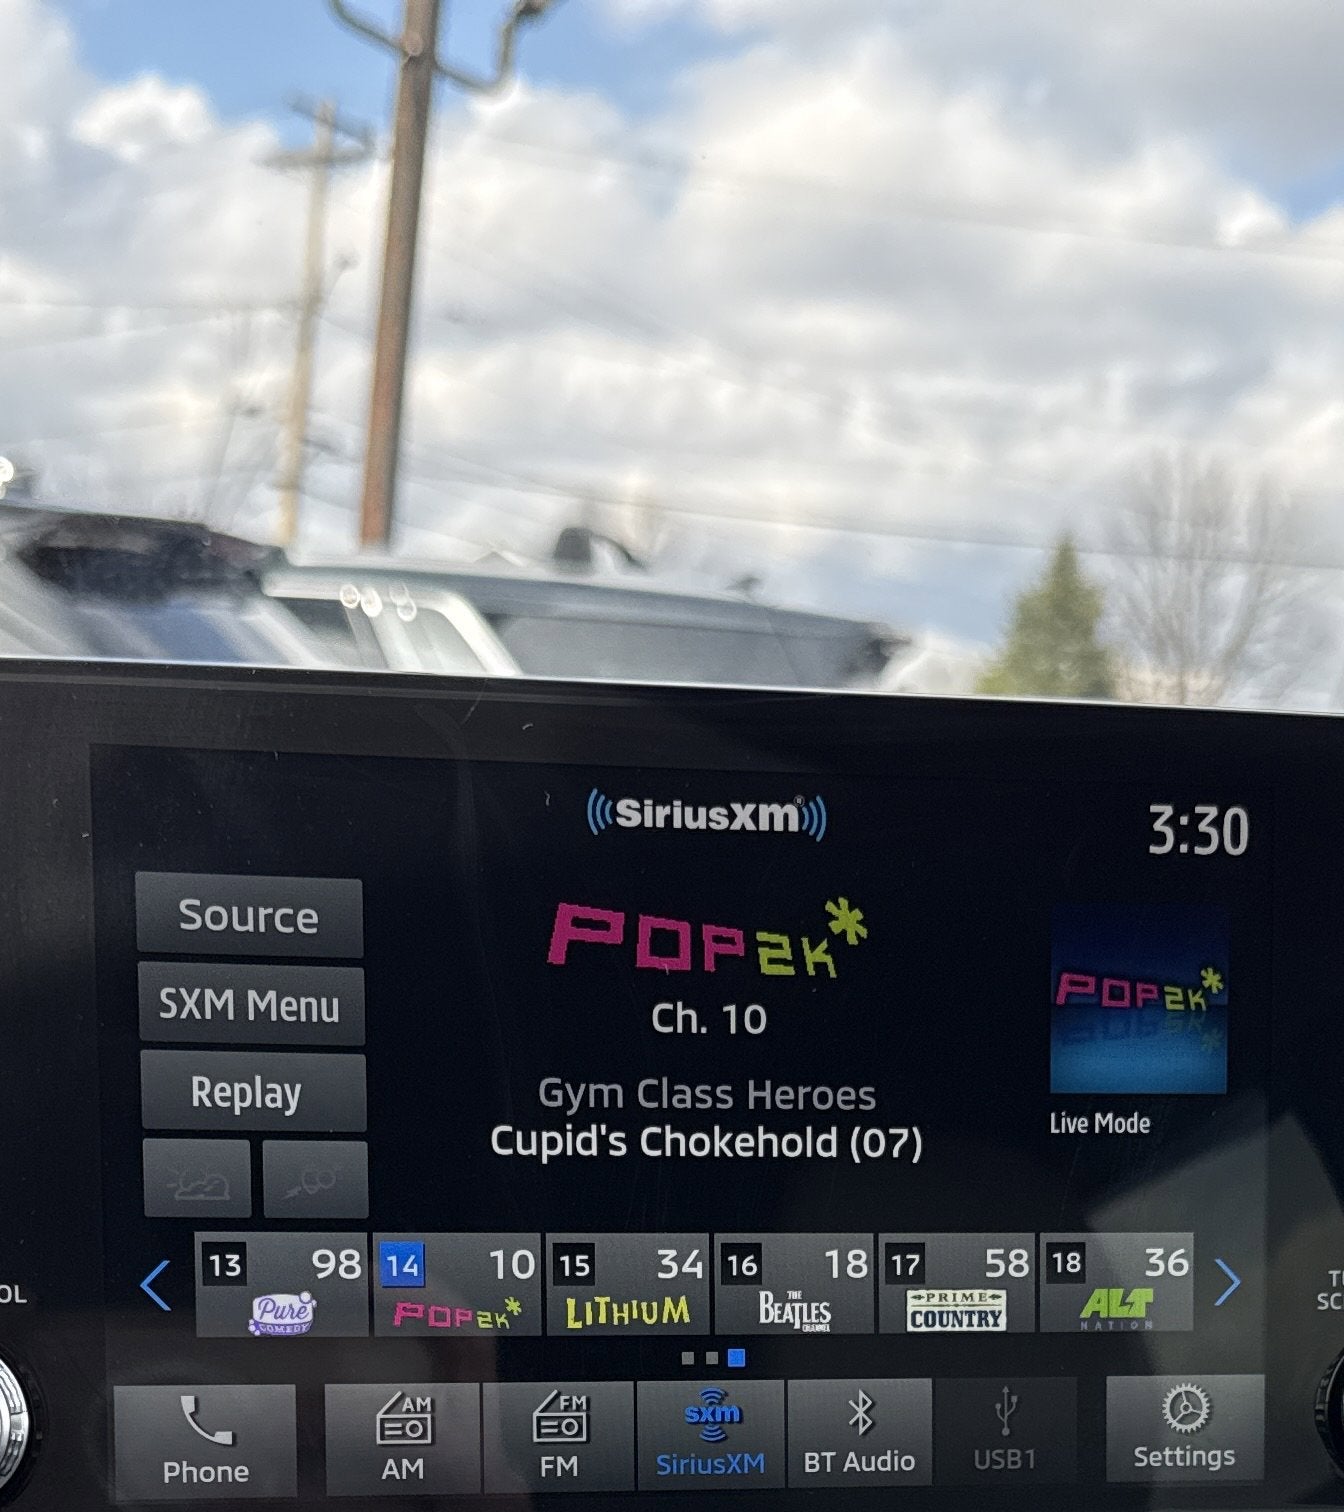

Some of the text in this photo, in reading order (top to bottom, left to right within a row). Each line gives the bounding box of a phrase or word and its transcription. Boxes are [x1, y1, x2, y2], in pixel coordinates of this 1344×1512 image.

[1149, 804, 1249, 855] 3:30
[178, 899, 319, 934] Source
[159, 986, 340, 1023] SXM Menu
[652, 1002, 767, 1034] Ch. 10
[191, 1076, 301, 1115] Replay
[539, 1077, 877, 1115] Gym Class Heroes
[1050, 1112, 1151, 1134] Live Mode
[491, 1124, 923, 1163] Cupid's Chokehold (07)
[209, 1254, 241, 1277] 13
[312, 1248, 362, 1280] 98
[387, 1256, 419, 1277] 14
[490, 1249, 536, 1280] 10
[559, 1255, 590, 1277] 15
[657, 1249, 704, 1279] 34
[727, 1254, 758, 1276] 16
[825, 1249, 869, 1279] 18
[891, 1254, 921, 1276] 17
[985, 1248, 1030, 1278] 58
[1052, 1252, 1082, 1274] 18
[1145, 1248, 1190, 1277] 36
[926, 1292, 988, 1302] PRIME
[1079, 1288, 1154, 1318] ALT
[258, 1297, 310, 1321] Pure
[566, 1295, 691, 1329] LITHIUM
[758, 1290, 832, 1330] BEATLES
[910, 1310, 1002, 1328] COUNTRY
[1080, 1320, 1153, 1331] NATION
[402, 1398, 432, 1412] AM
[560, 1396, 587, 1410] FM
[684, 1405, 740, 1423] sxm
[381, 1459, 424, 1479] AM
[540, 1456, 578, 1477] FM
[656, 1453, 765, 1475] SiriusXM
[804, 1451, 916, 1473] BT Audio
[974, 1449, 1036, 1469] USB1
[1134, 1446, 1236, 1471] Settings
[163, 1462, 249, 1483] Phone
